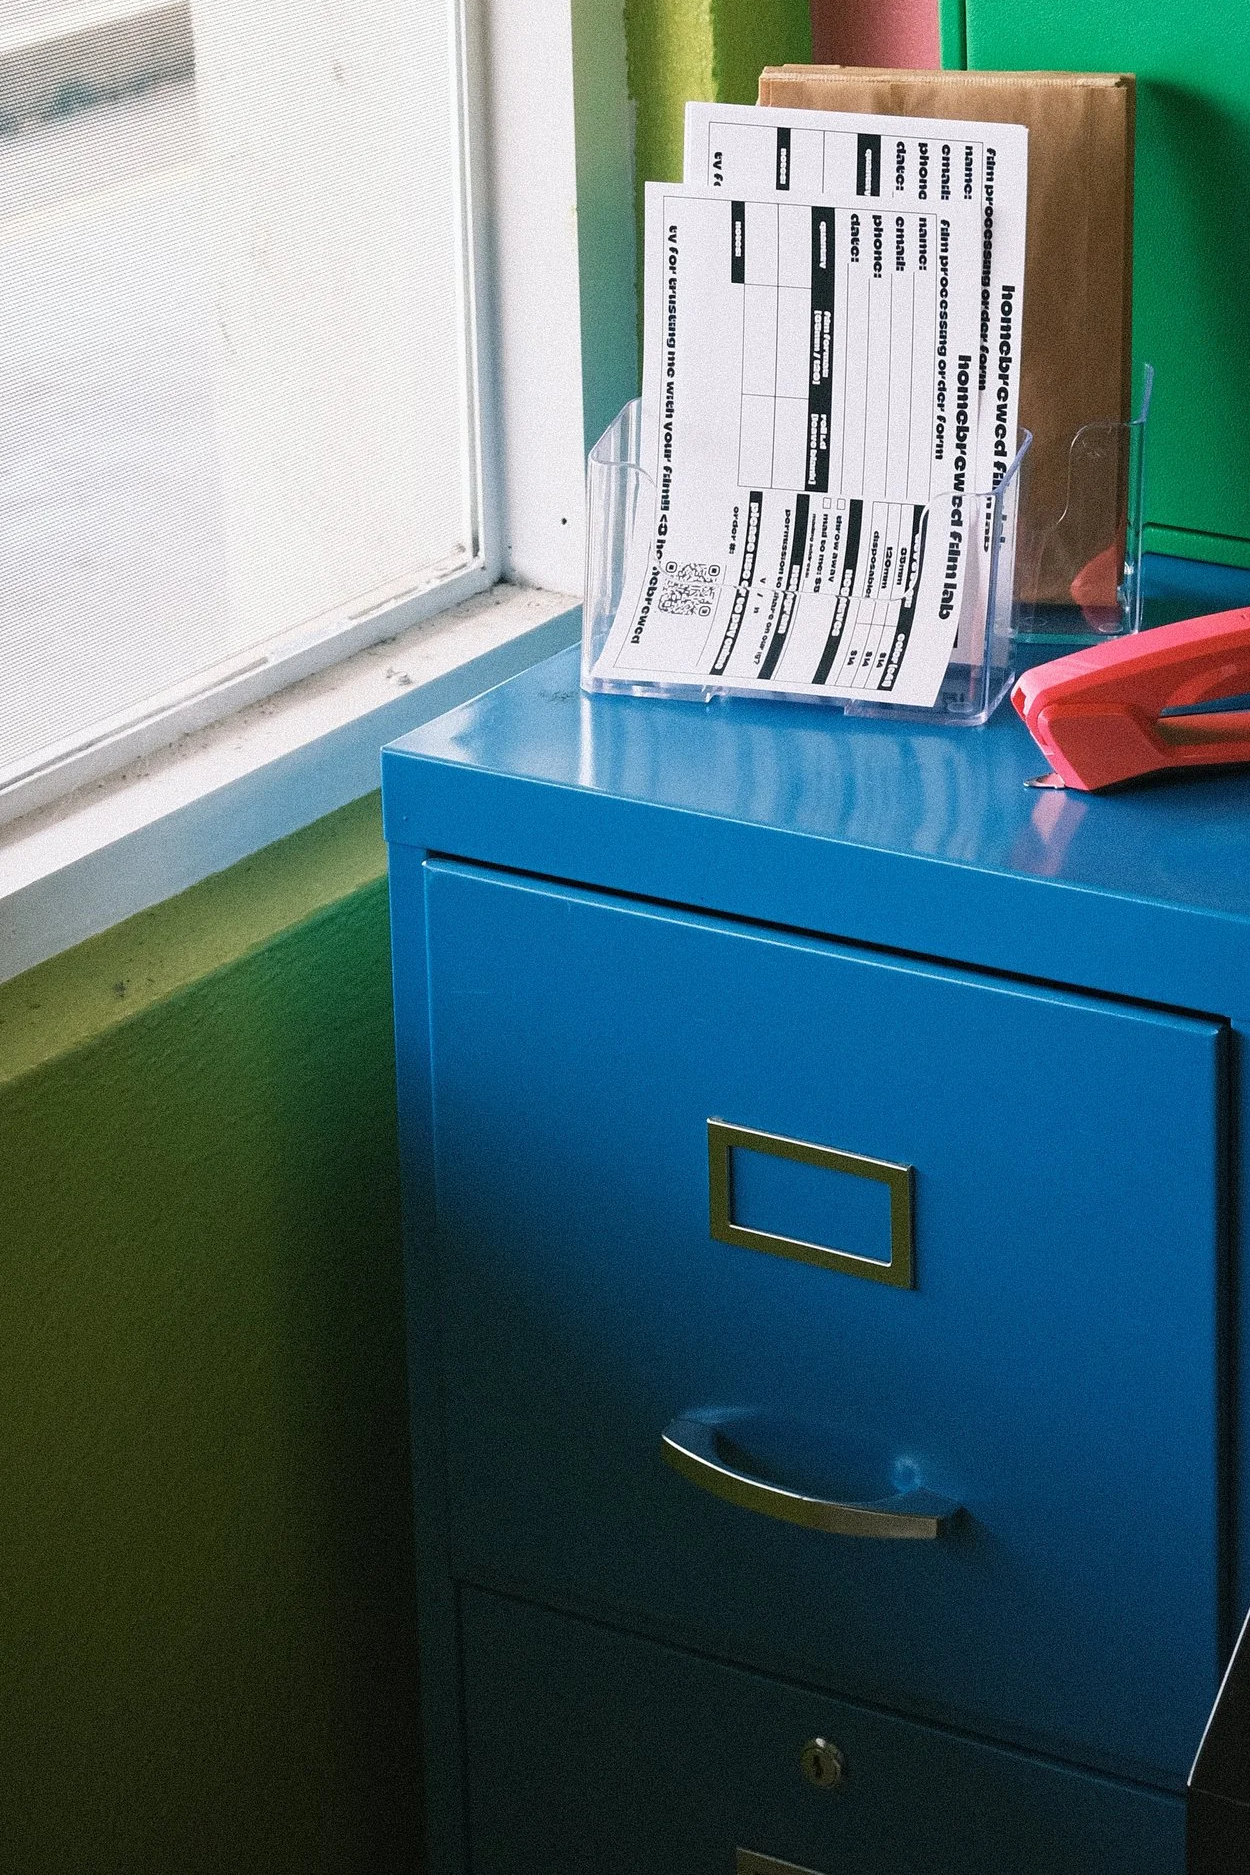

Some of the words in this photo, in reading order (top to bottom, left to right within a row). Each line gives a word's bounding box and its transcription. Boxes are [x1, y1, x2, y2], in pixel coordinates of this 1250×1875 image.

[712, 151, 723, 171] ty
[895, 140, 907, 192] date:
[940, 143, 951, 201] email:
[963, 145, 974, 200] name:
[985, 147, 997, 183] film
[668, 224, 678, 245] ty
[818, 220, 827, 270] quantity
[850, 213, 860, 263] date:
[872, 214, 884, 279] phone:
[895, 215, 906, 272] email:
[918, 217, 928, 271] name:
[940, 218, 951, 254] film
[980, 183, 995, 288] processing
[667, 245, 679, 276] for
[666, 276, 678, 349] trusting
[936, 255, 949, 357] processing
[980, 289, 991, 341] order
[666, 350, 677, 379] me
[936, 359, 947, 412] order
[977, 344, 990, 391] form
[994, 285, 1016, 460] homebrewed
[664, 380, 675, 419] with
[661, 420, 674, 465] your
[934, 413, 946, 461] form
[950, 354, 972, 528] homebrewed
[729, 506, 740, 541] order
[745, 501, 760, 553] please
[778, 508, 791, 576] permission
[819, 513, 829, 540] mail
[833, 514, 843, 552] throw
[742, 552, 754, 581] use
[814, 554, 826, 577] me:
[817, 540, 828, 554] to
[827, 552, 838, 583] away
[881, 546, 894, 590] 120mm
[896, 546, 908, 586] 35mm
[945, 530, 963, 581] film
[775, 575, 784, 589] to
[938, 583, 958, 620] lab
[725, 612, 741, 638] pay
[733, 596, 746, 614] to
[758, 634, 768, 652] our
[763, 621, 772, 635] on
[892, 632, 906, 664] color
